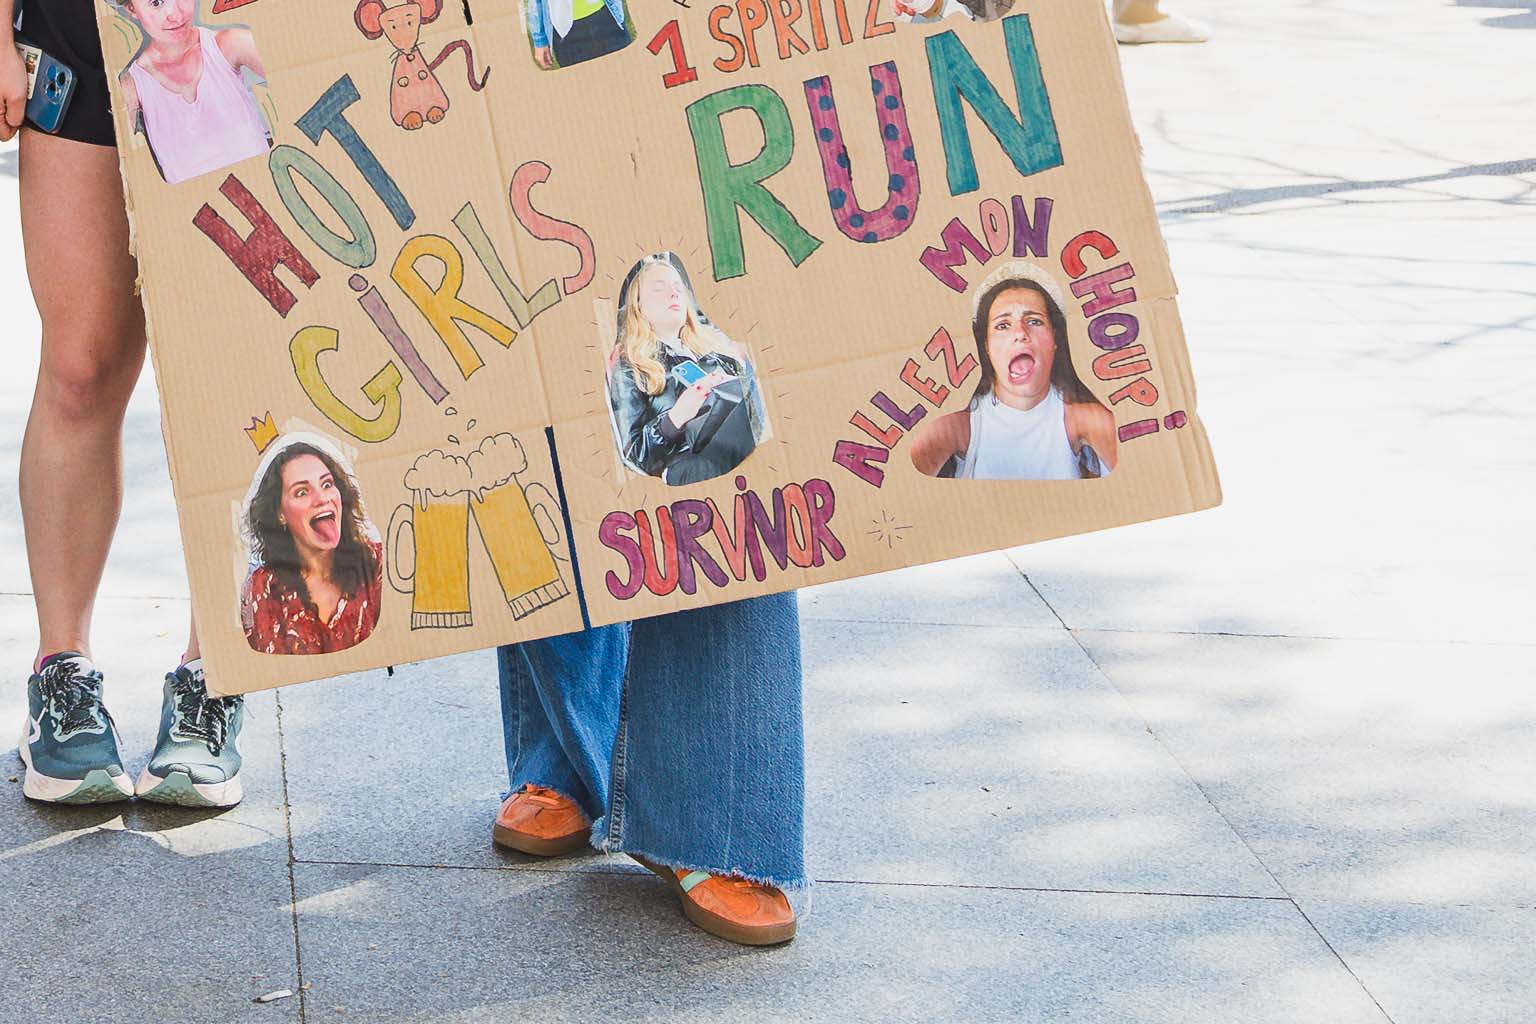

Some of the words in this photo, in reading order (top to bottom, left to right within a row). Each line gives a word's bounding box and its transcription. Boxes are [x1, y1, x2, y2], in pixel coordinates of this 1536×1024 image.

[646, 18, 699, 89] 1
[685, 12, 1066, 283] RUN
[190, 72, 417, 319] HOT
[831, 326, 980, 490] ALLEZ
[918, 194, 1055, 294] MON
